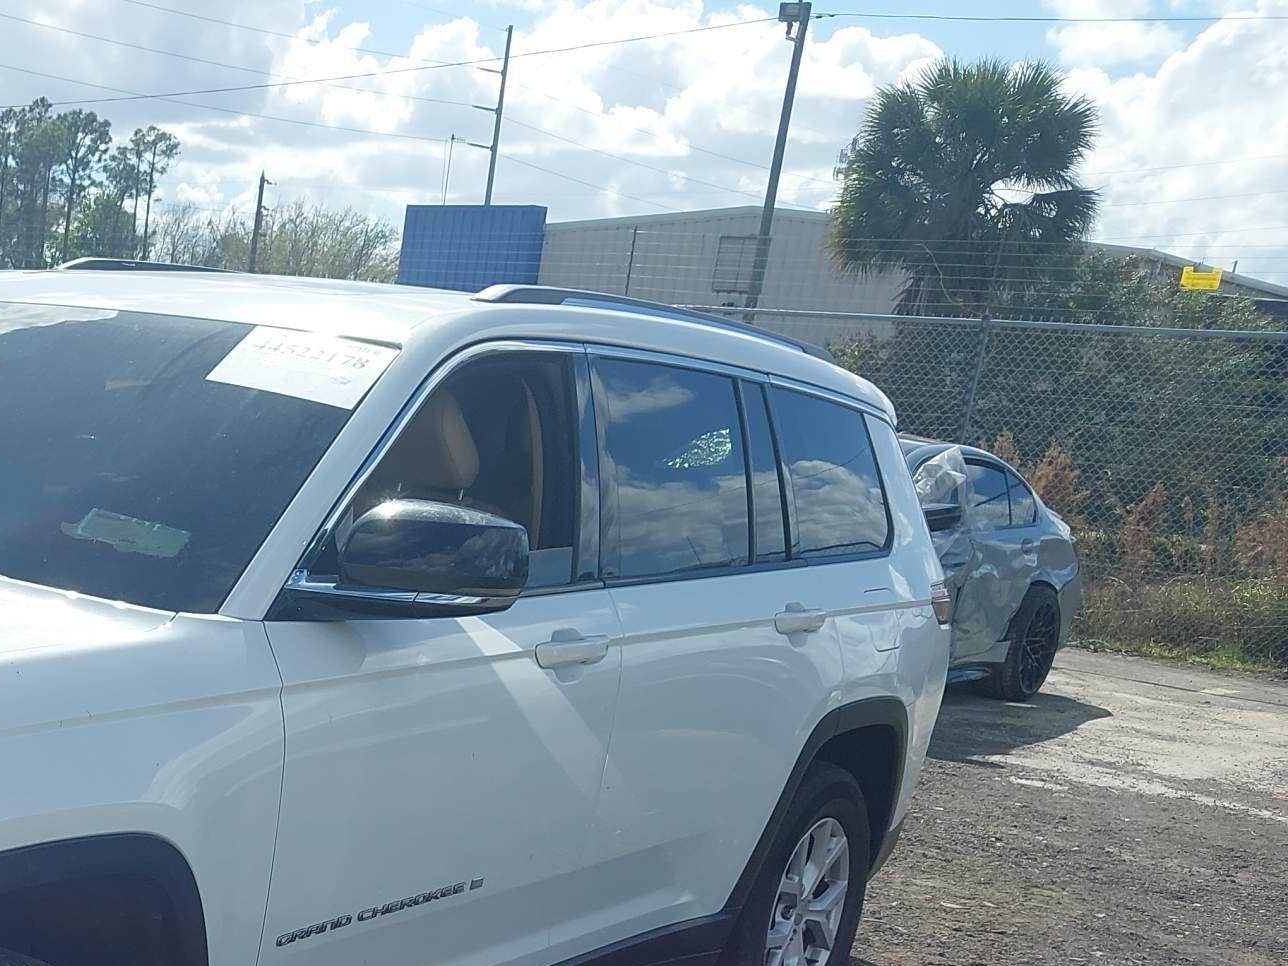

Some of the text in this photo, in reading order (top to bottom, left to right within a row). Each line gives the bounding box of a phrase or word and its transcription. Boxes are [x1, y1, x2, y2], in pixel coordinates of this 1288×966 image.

[254, 340, 370, 370] 44522178
[275, 881, 467, 948] GRAND CHEROKEE
